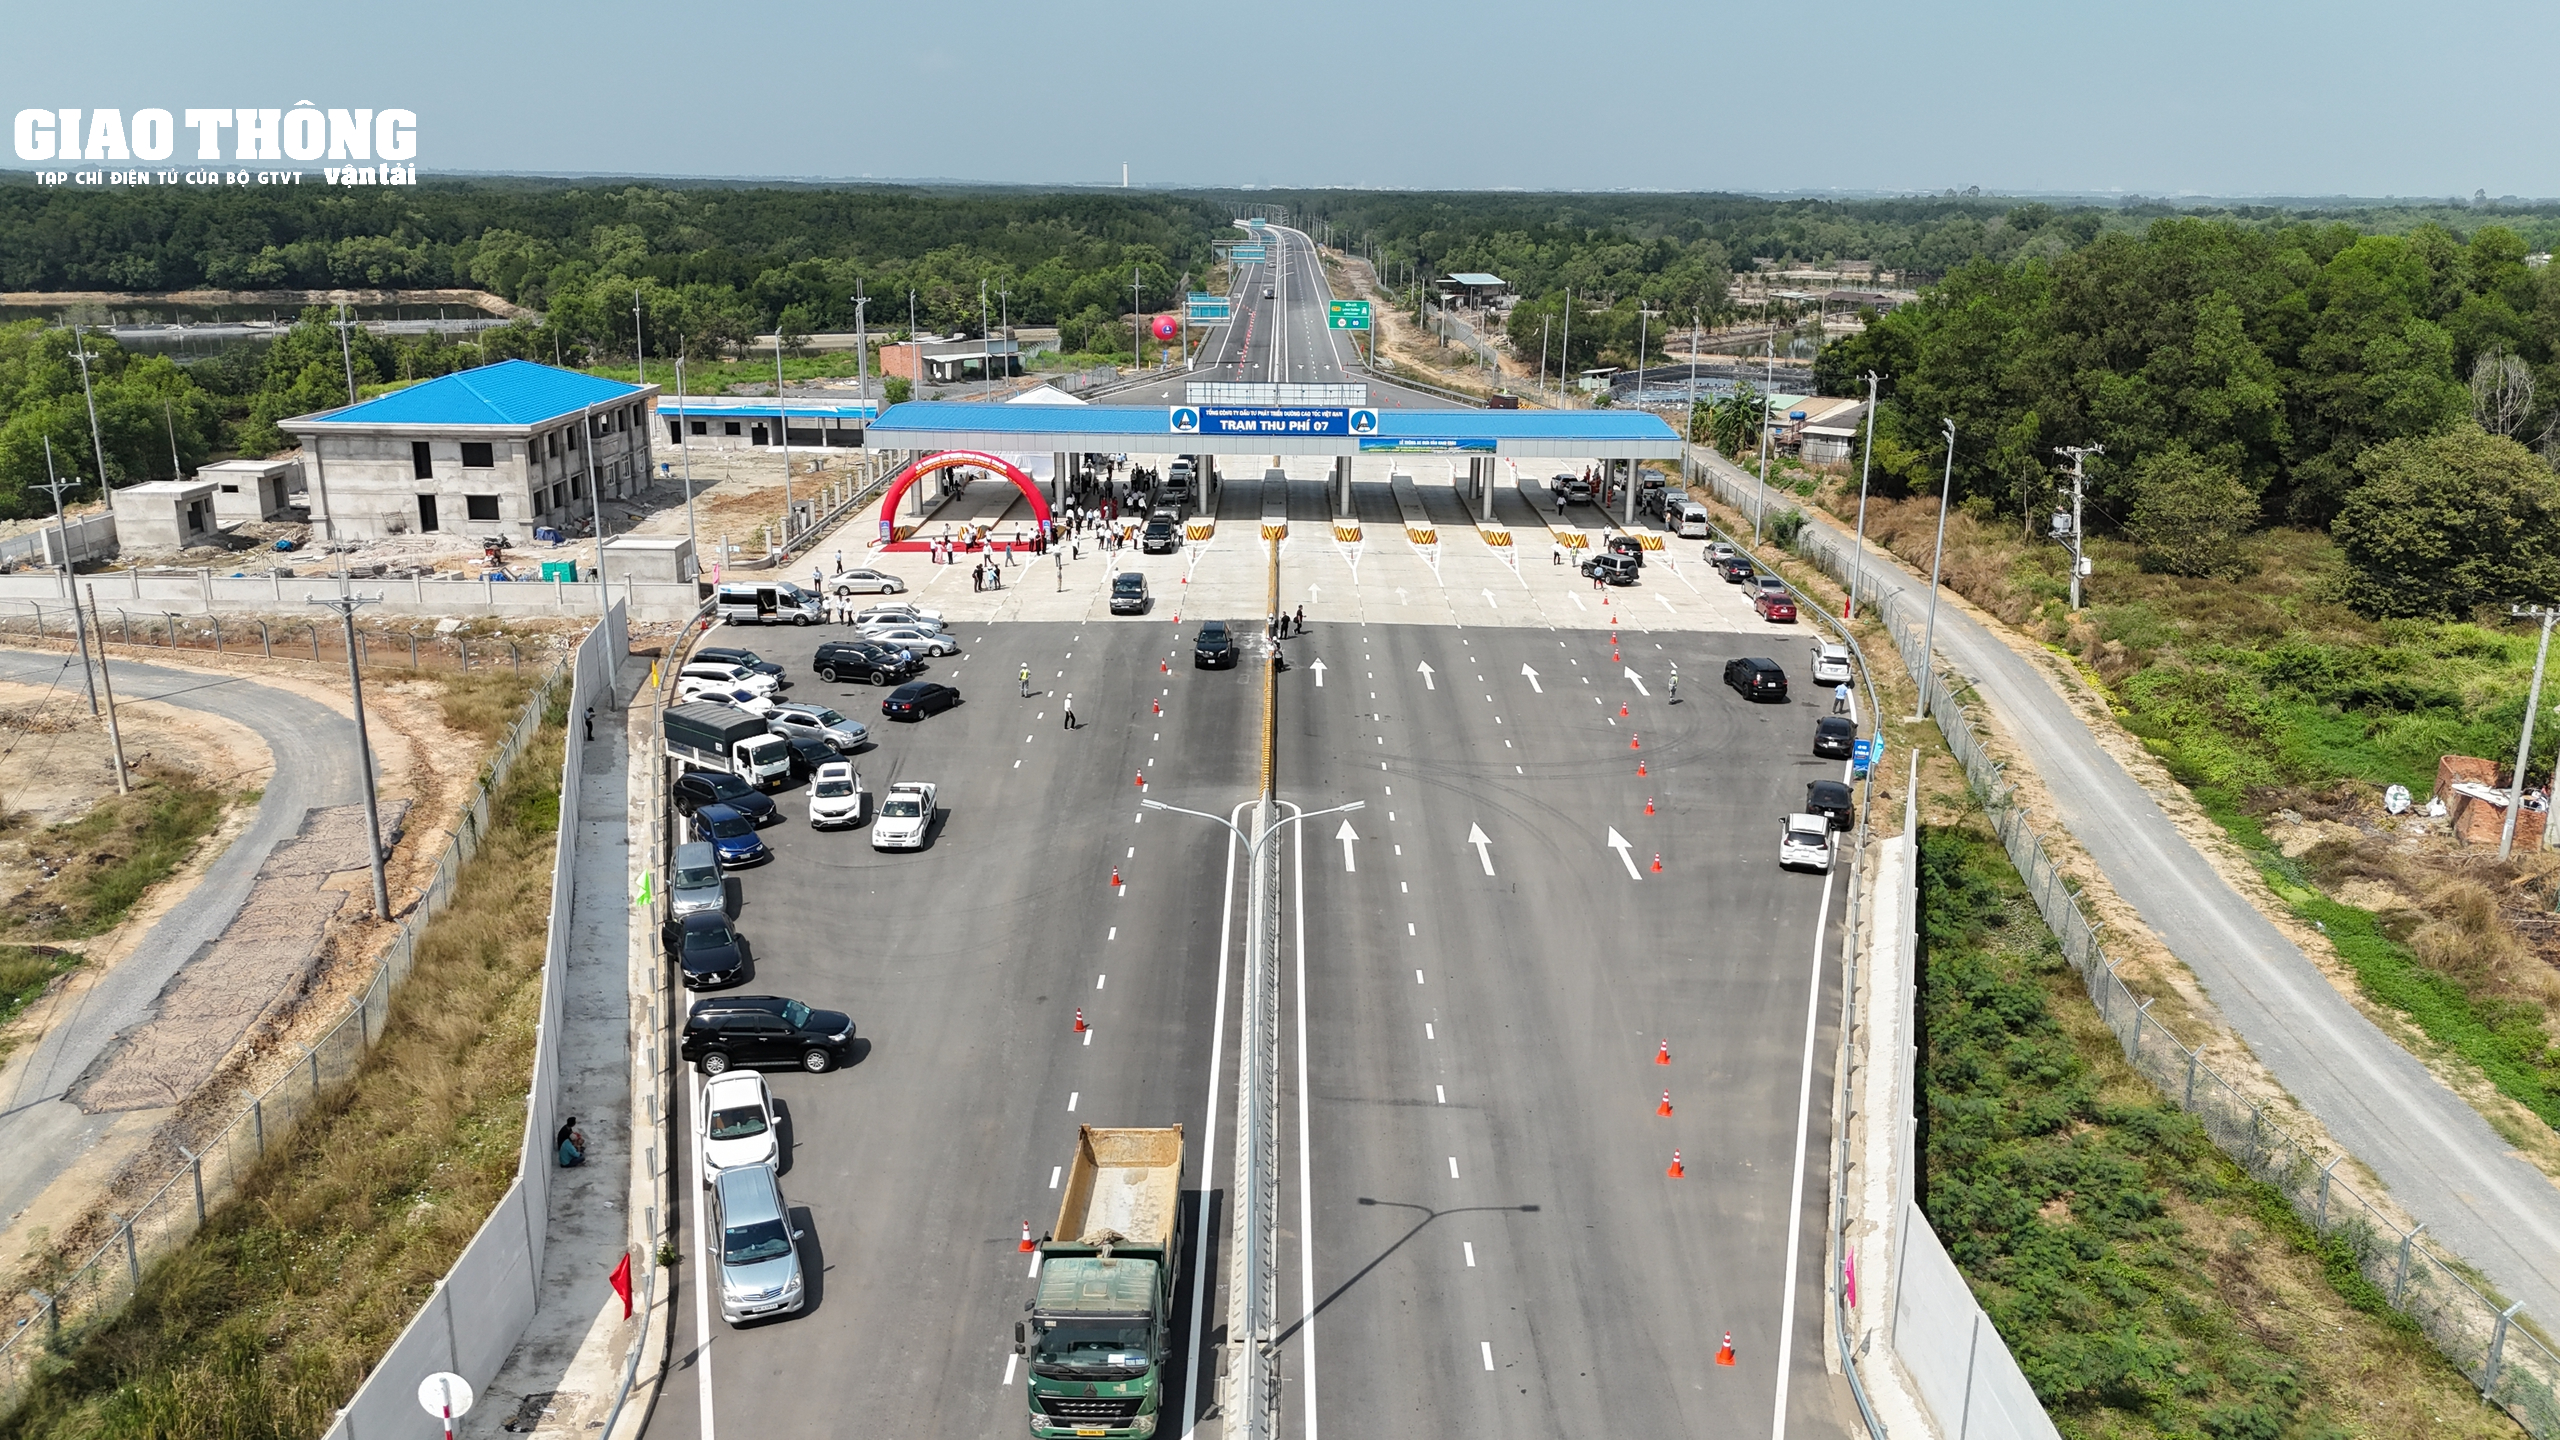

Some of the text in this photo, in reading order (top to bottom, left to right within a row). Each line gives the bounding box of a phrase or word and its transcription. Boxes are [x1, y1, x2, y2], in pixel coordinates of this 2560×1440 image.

[1220, 418, 1329, 432] TRẠM THU PHÍ 07
